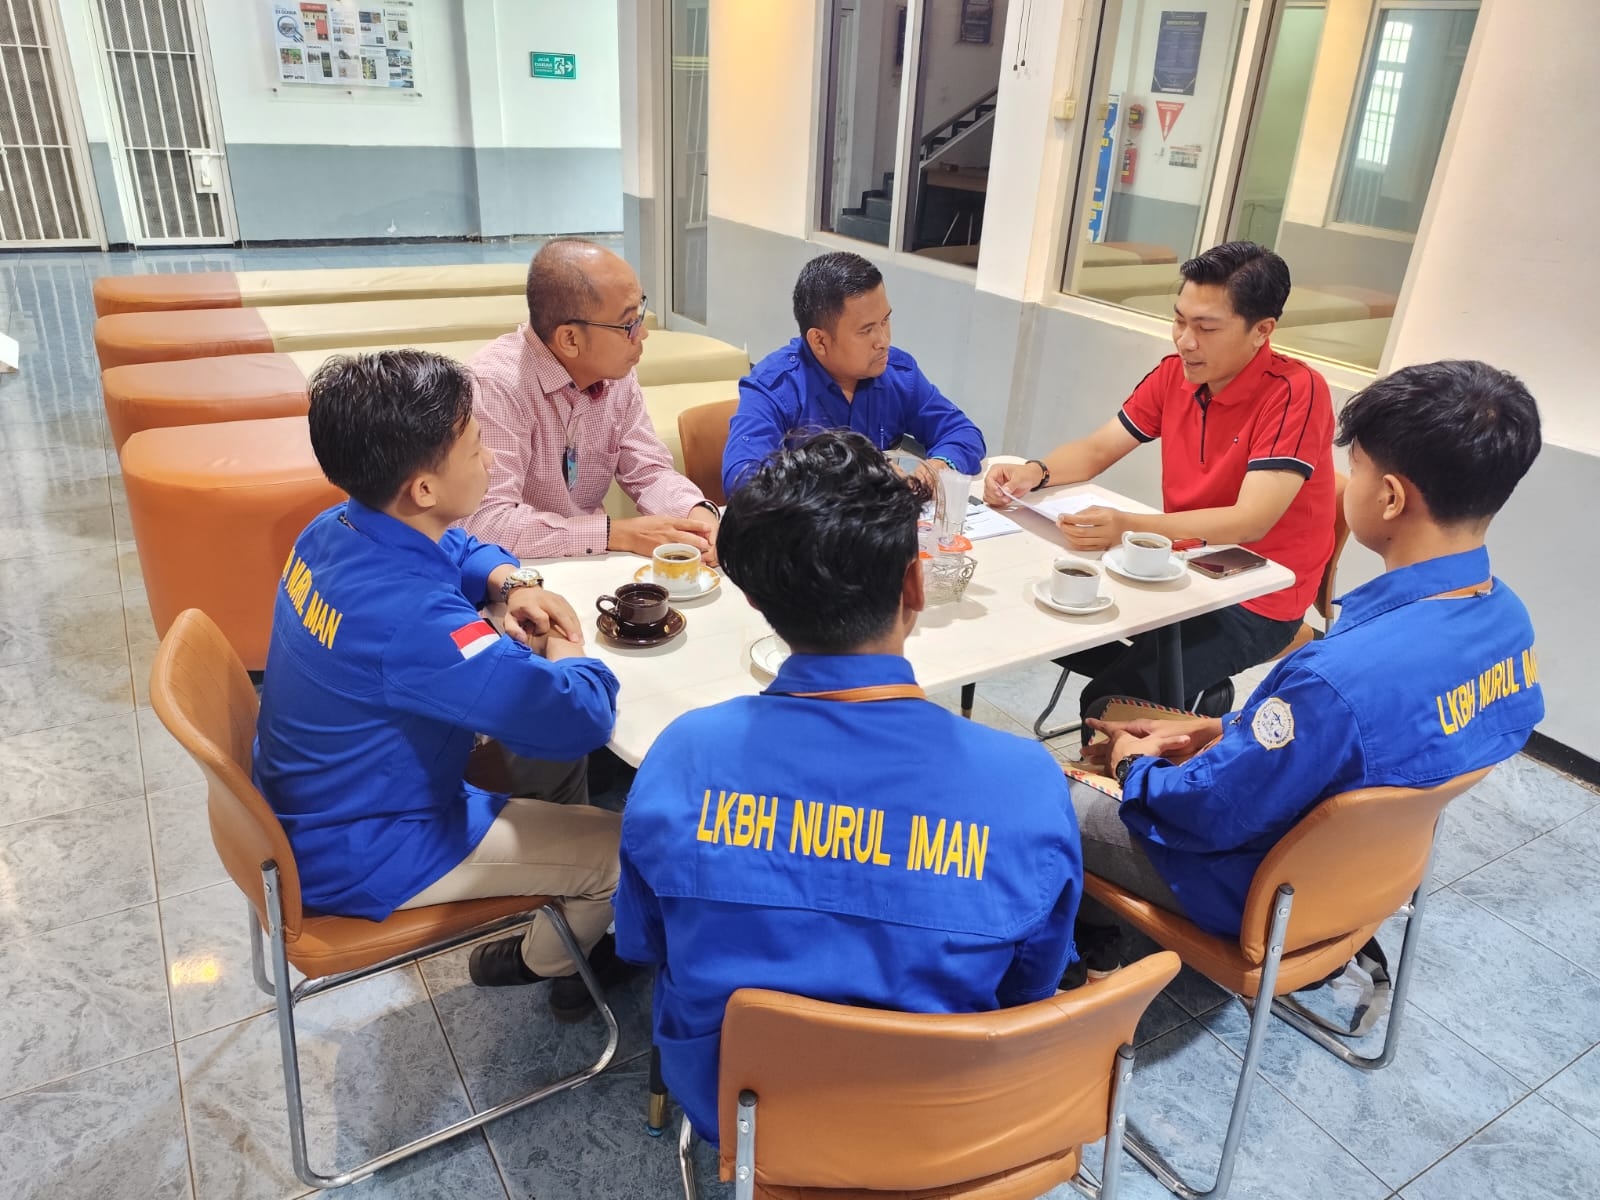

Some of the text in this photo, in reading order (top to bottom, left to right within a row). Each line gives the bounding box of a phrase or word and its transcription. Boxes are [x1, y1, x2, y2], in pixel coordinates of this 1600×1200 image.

[302, 590, 343, 651] IMAN
[1436, 678, 1476, 735] LKBH
[1479, 656, 1520, 712] NURUL
[696, 789, 990, 881] LKBH NURUL IMAN
